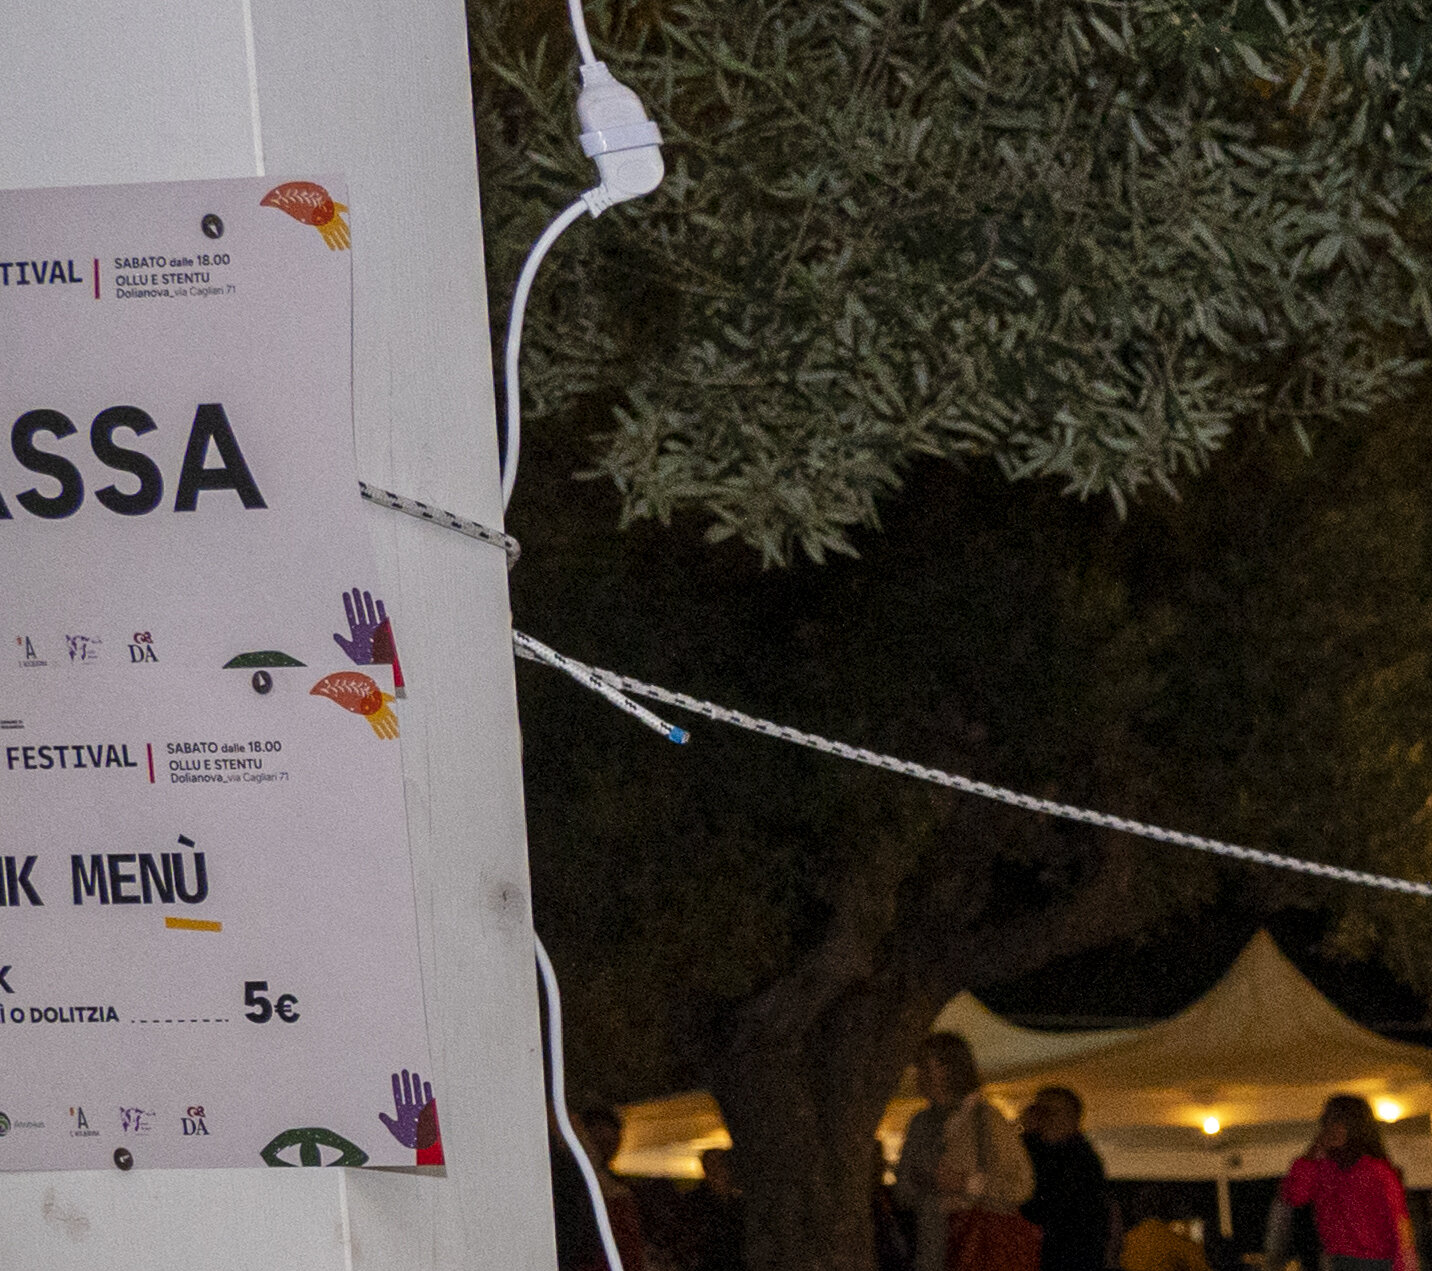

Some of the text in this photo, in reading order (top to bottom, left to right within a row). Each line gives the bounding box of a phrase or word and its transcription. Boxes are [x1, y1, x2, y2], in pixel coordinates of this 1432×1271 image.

[114, 257, 166, 269] SABATO
[196, 254, 230, 266] 18.00
[115, 272, 210, 286] OLLU E STENTU
[0, 403, 268, 520] SSA
[167, 742, 218, 754] SABATO
[248, 740, 281, 752] 18.00
[6, 744, 137, 770] FESTIVAL
[169, 759, 262, 771] OLLU E STENTU
[71, 833, 208, 904] MENÙ
[243, 980, 300, 1024] 5€
[10, 1007, 25, 1023] O
[30, 1006, 119, 1023] DOLITZIA
